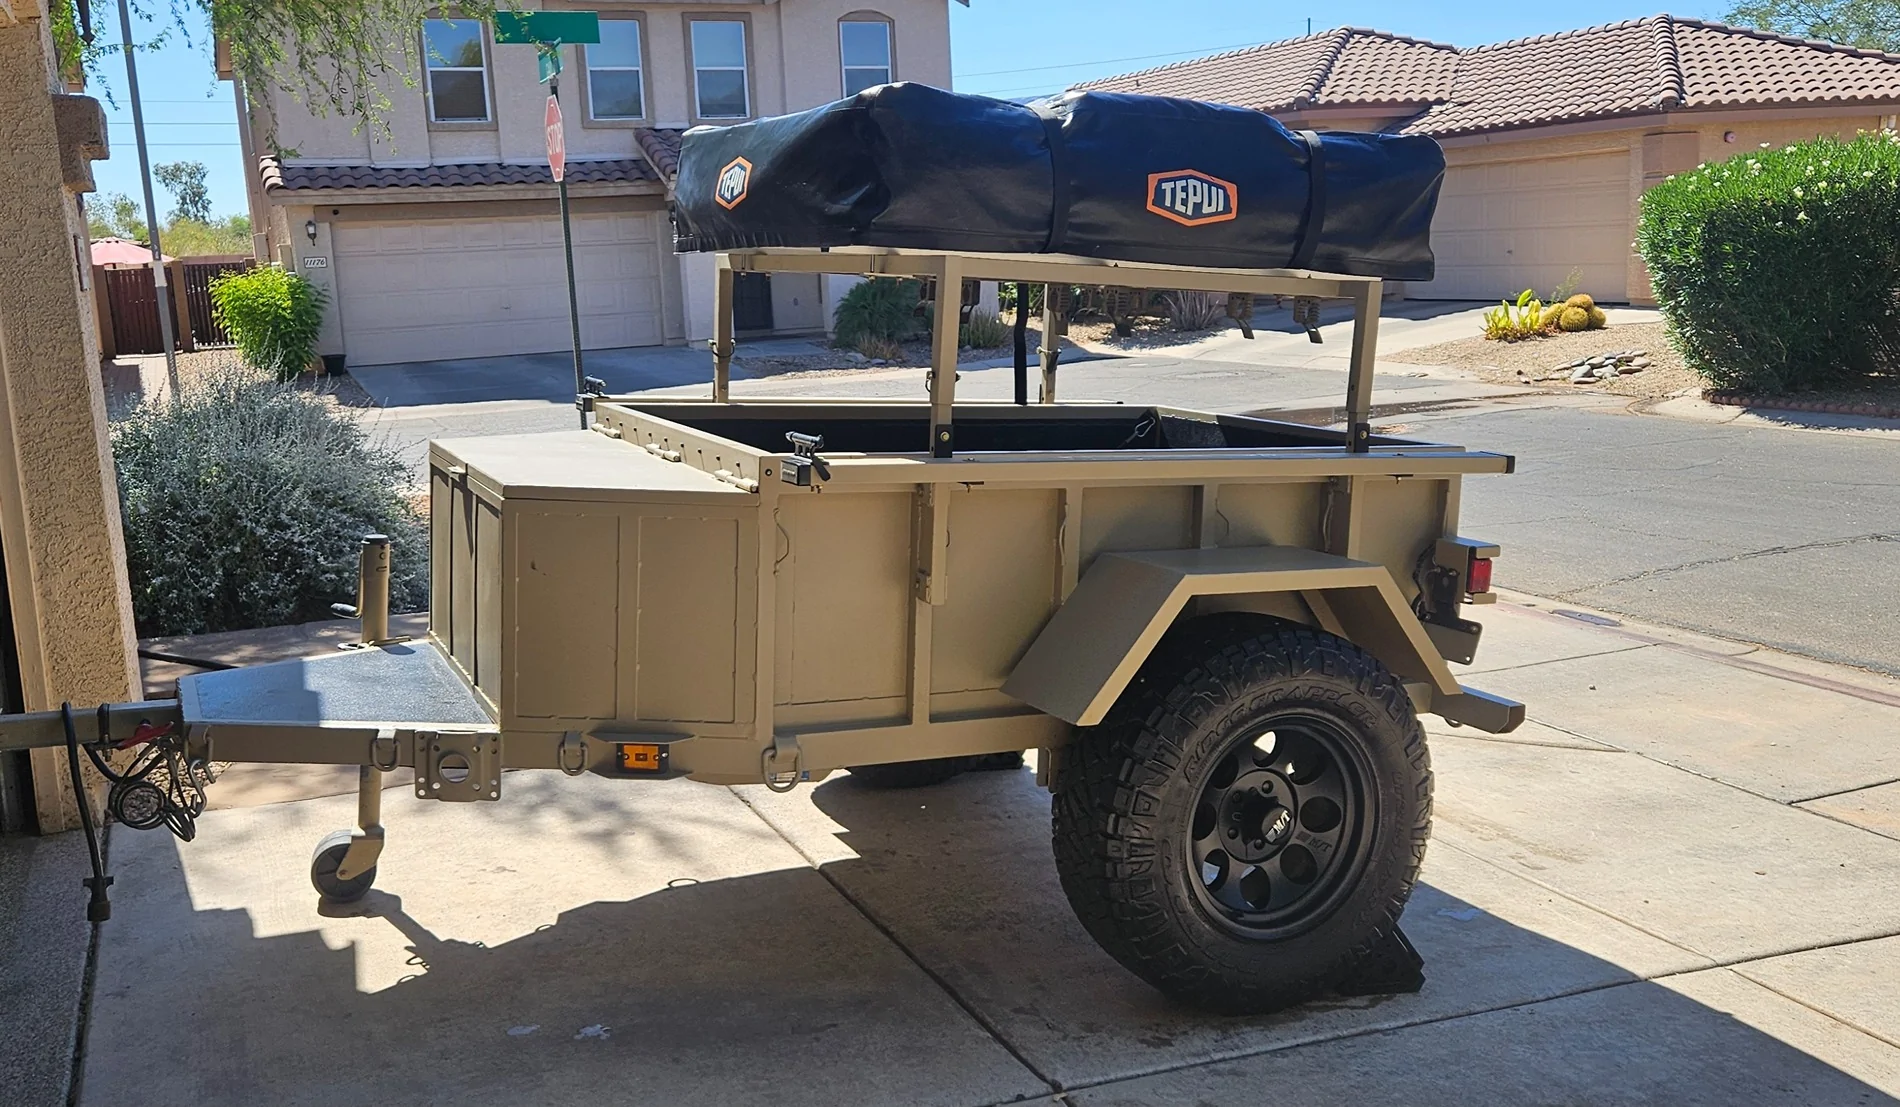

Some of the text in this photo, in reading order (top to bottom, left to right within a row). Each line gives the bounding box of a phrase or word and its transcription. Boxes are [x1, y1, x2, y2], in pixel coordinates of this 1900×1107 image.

[547, 122, 562, 156] STOP
[721, 165, 746, 200] TEPUI
[1161, 178, 1224, 216] TEPUI
[1272, 809, 1291, 835] M/T
[1308, 836, 1332, 852] M/T
